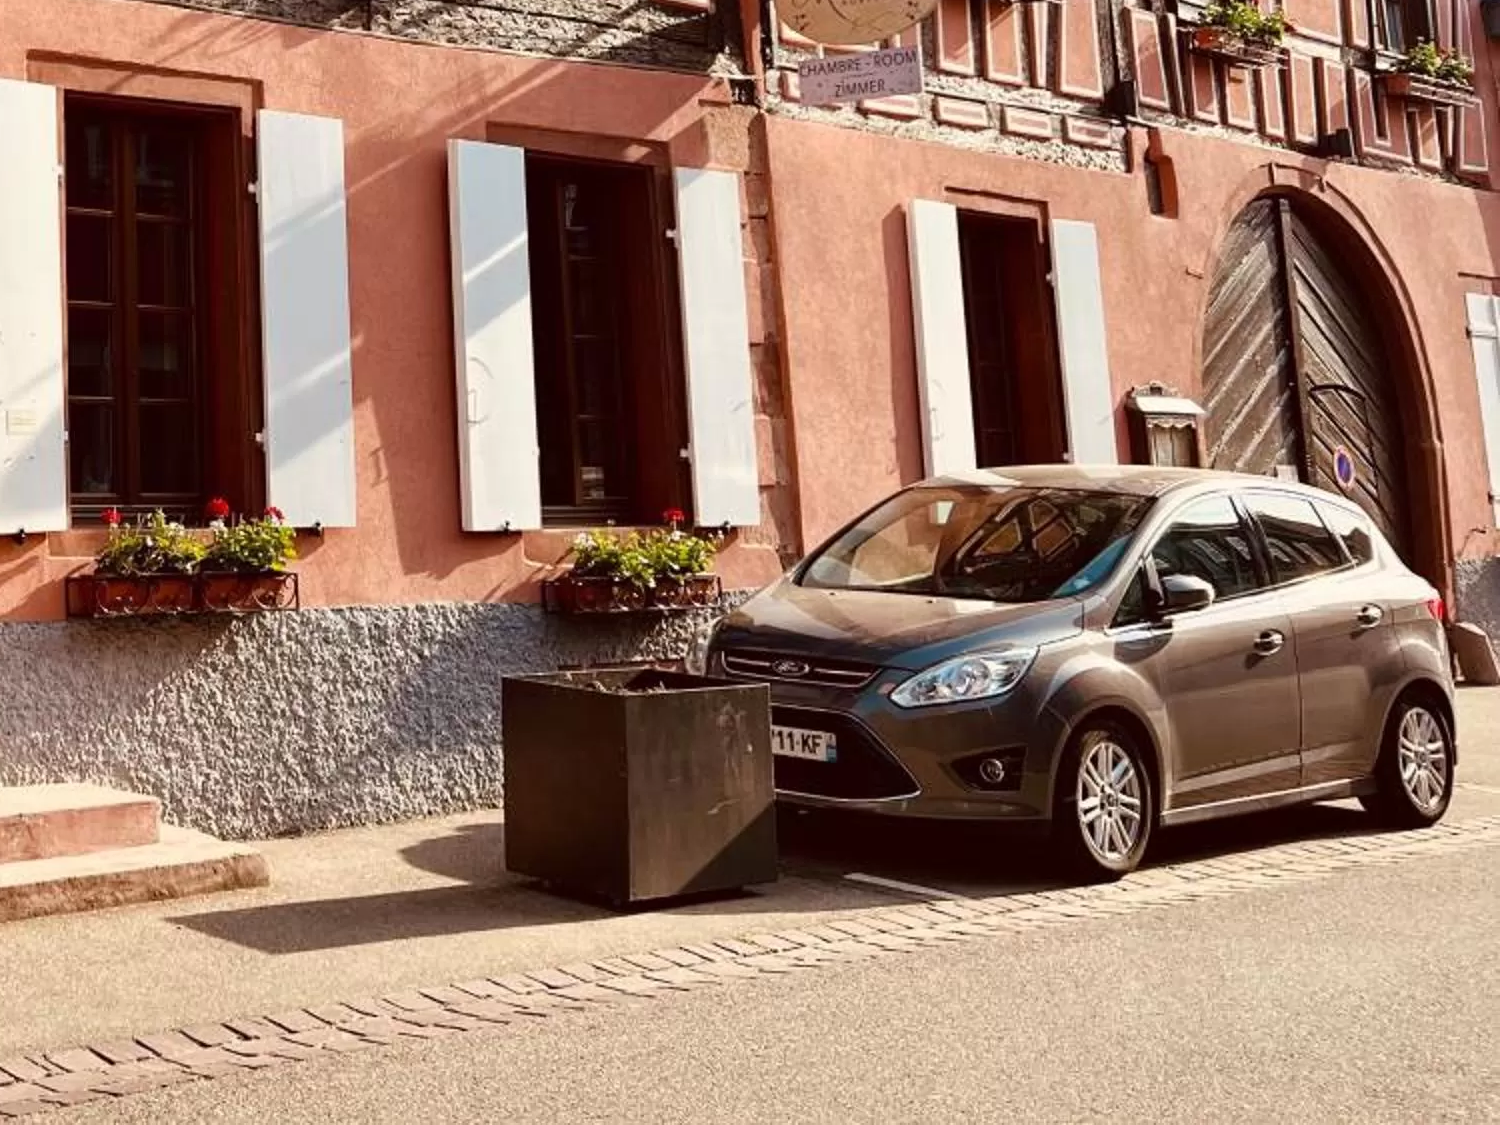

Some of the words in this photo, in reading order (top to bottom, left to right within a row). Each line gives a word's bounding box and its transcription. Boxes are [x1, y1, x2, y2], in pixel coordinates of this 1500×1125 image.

[800, 59, 861, 78] CHAMBRE
[873, 51, 917, 69] ROOM
[835, 79, 886, 98] ZIMMER
[771, 729, 823, 754] 11-KF
